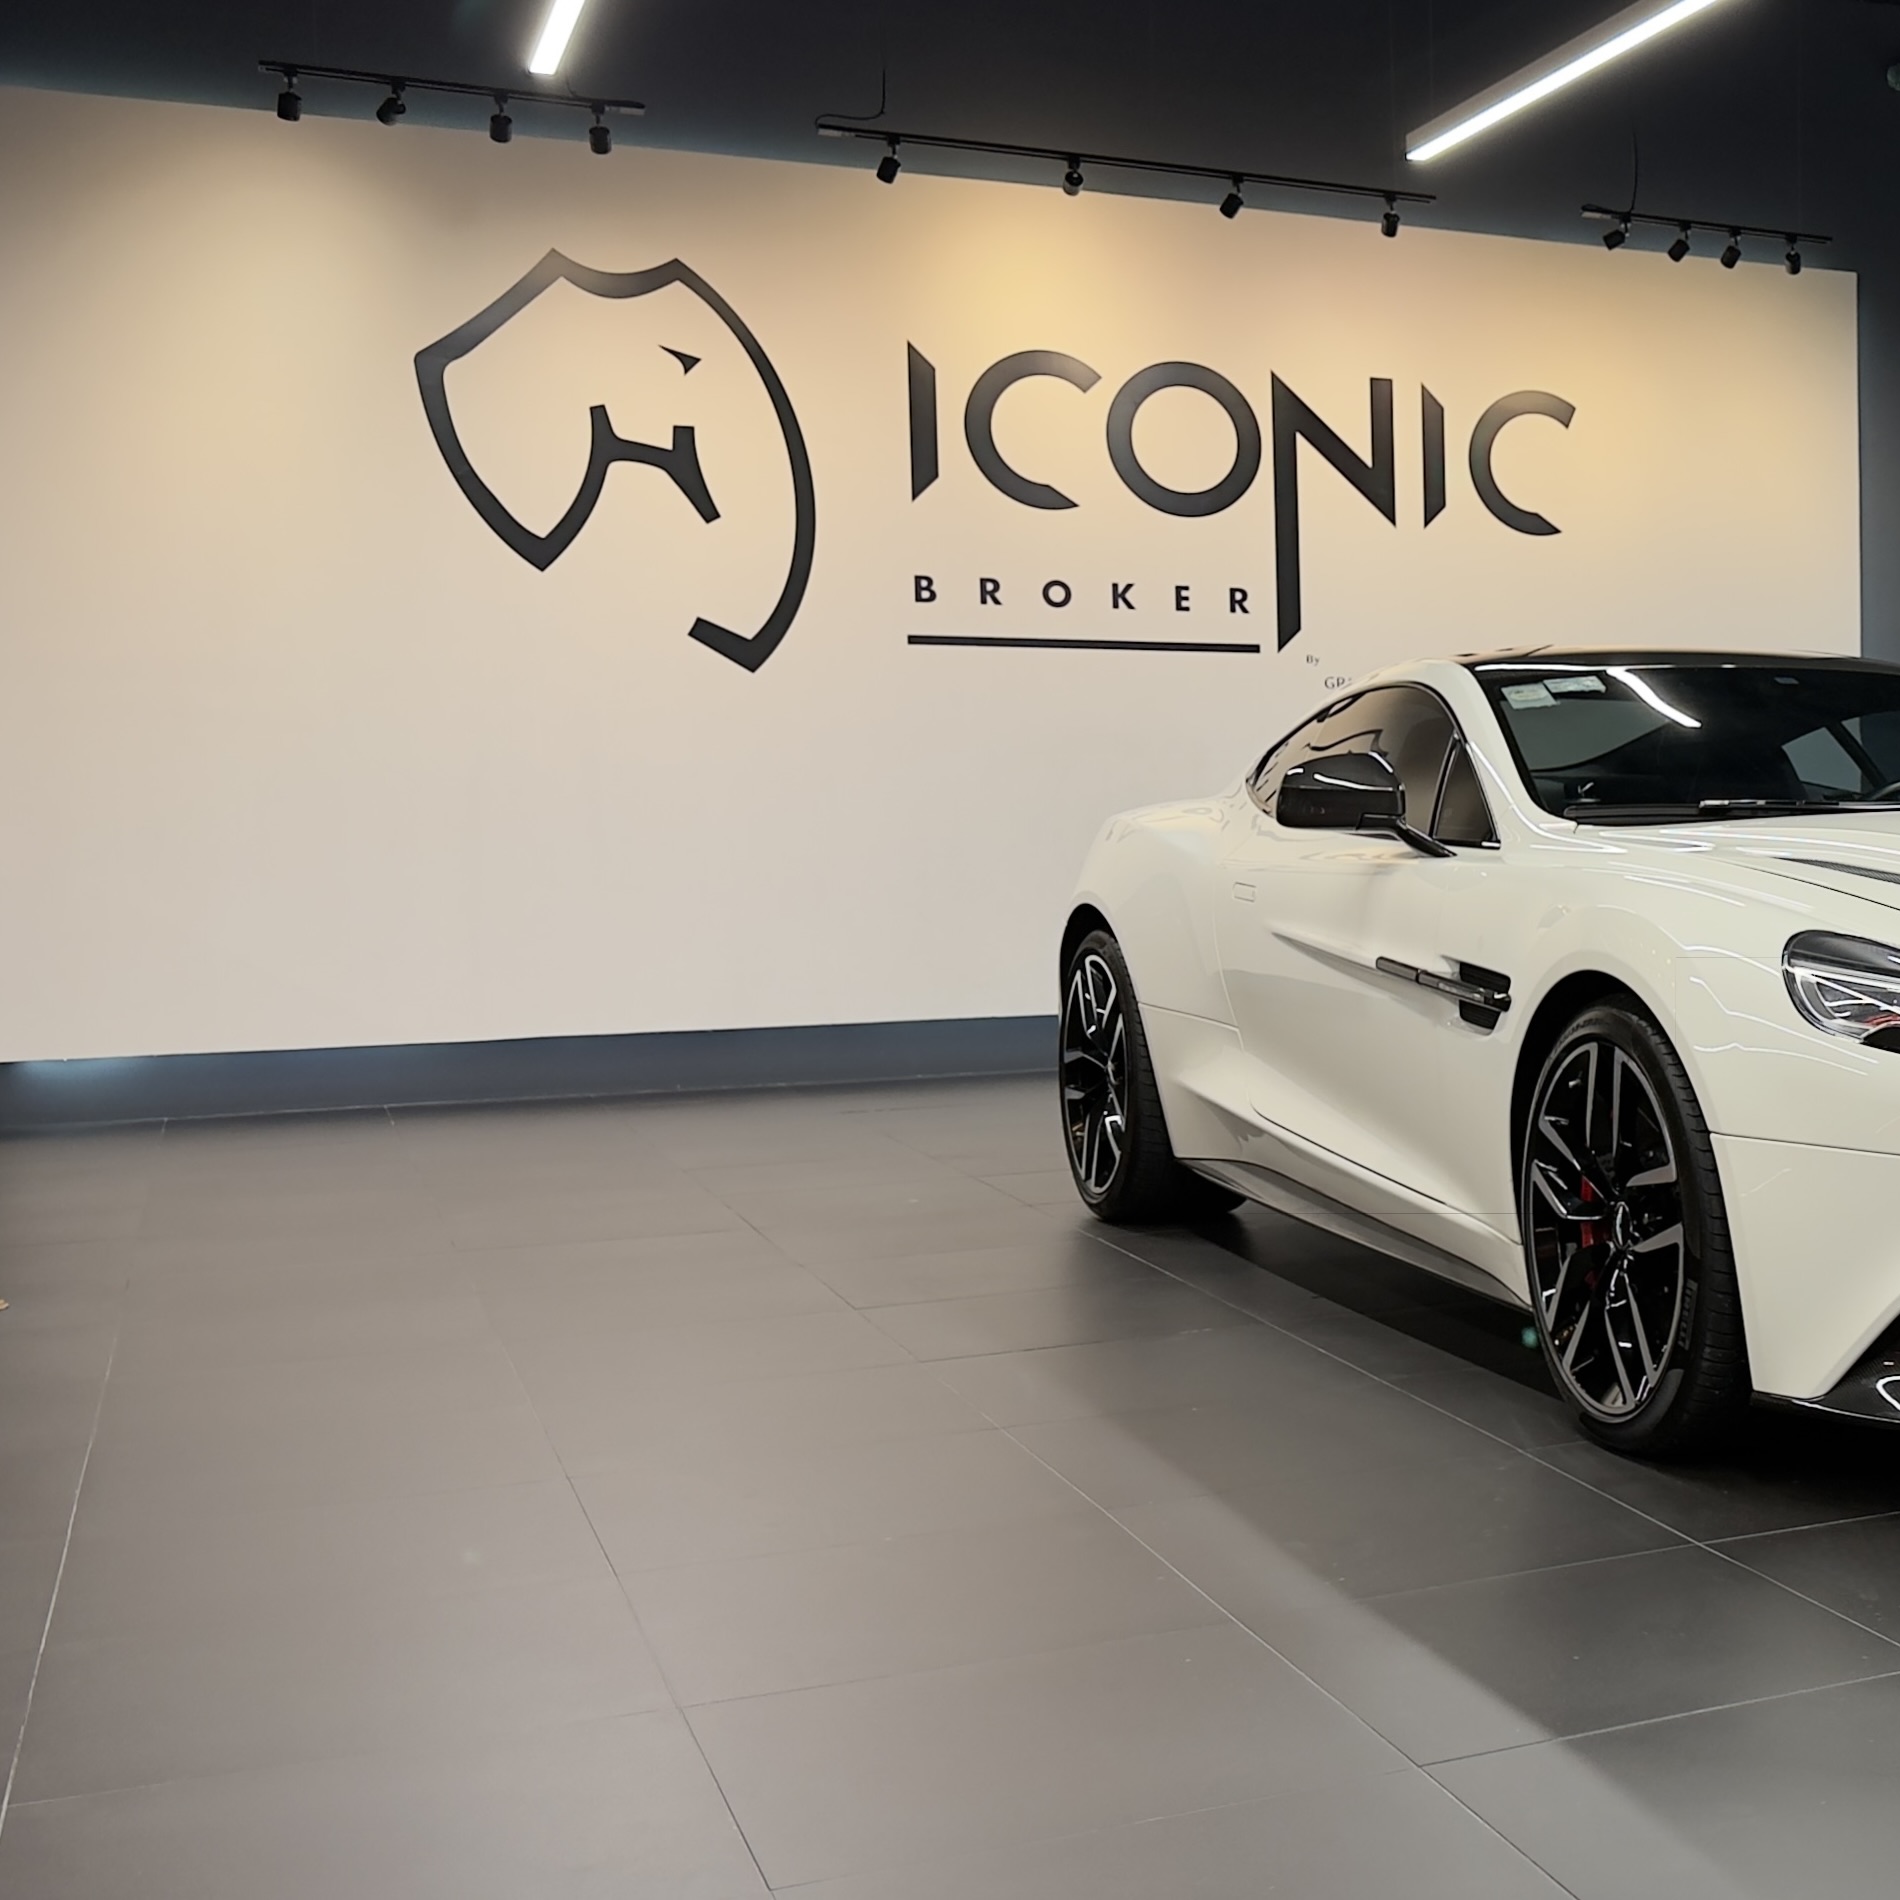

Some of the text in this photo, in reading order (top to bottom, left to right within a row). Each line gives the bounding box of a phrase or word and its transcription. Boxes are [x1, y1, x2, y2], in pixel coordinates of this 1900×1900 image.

[907, 341, 1575, 653] ICONIC
[914, 575, 1250, 614] BROKER
[1306, 654, 1320, 667] By
